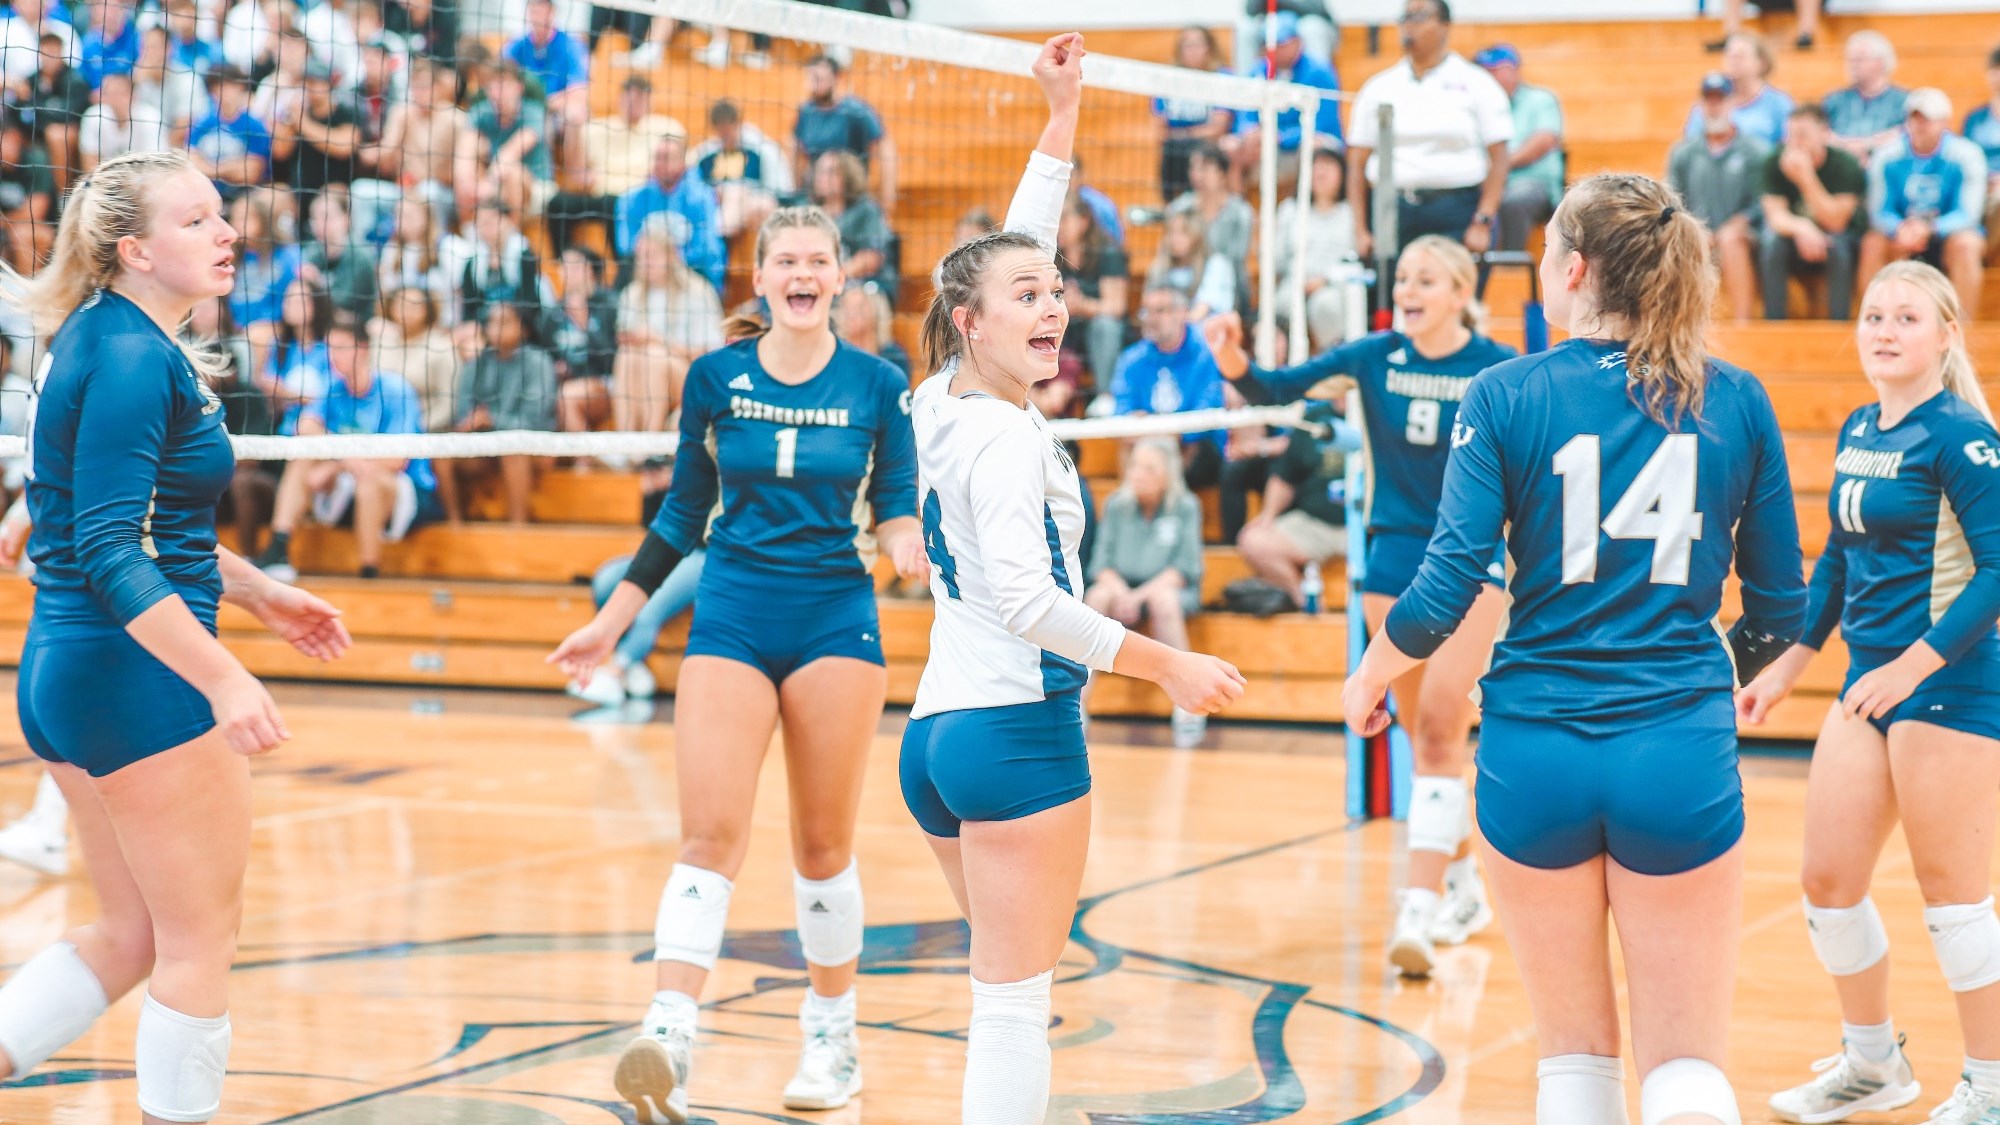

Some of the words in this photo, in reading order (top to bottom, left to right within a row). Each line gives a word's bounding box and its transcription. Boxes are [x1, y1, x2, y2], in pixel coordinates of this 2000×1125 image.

[1406, 399, 1441, 446] 9
[775, 428, 798, 478] 1
[1552, 433, 1703, 586] 14
[1838, 478, 1867, 534] 11
